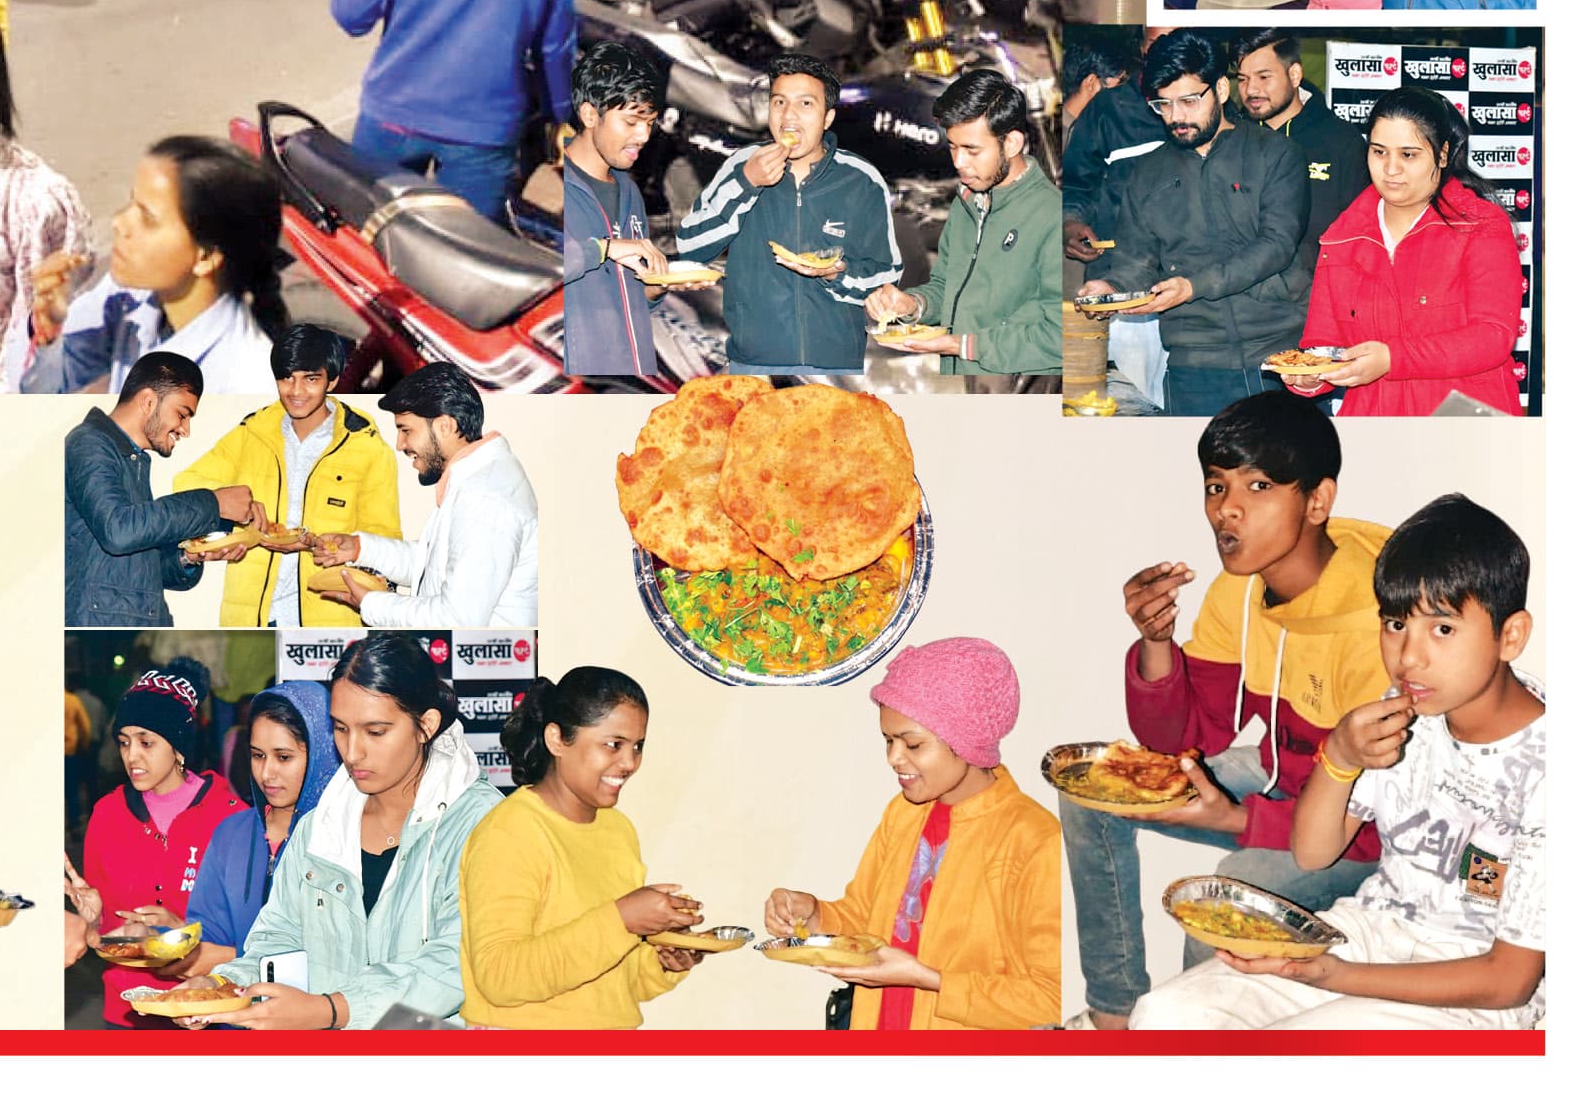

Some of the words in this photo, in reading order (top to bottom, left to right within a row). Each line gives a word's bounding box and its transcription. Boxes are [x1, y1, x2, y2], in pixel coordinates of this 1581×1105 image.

[1334, 58, 1382, 76] खुलासा
[1404, 60, 1452, 79] खुलासा
[1472, 62, 1517, 80] खुलासा
[1471, 105, 1517, 125] खुलासा
[1471, 149, 1516, 168] खुलासा
[286, 643, 344, 666] खुलासा
[456, 643, 512, 666] खुलासा
[458, 696, 513, 720] खुलासा
